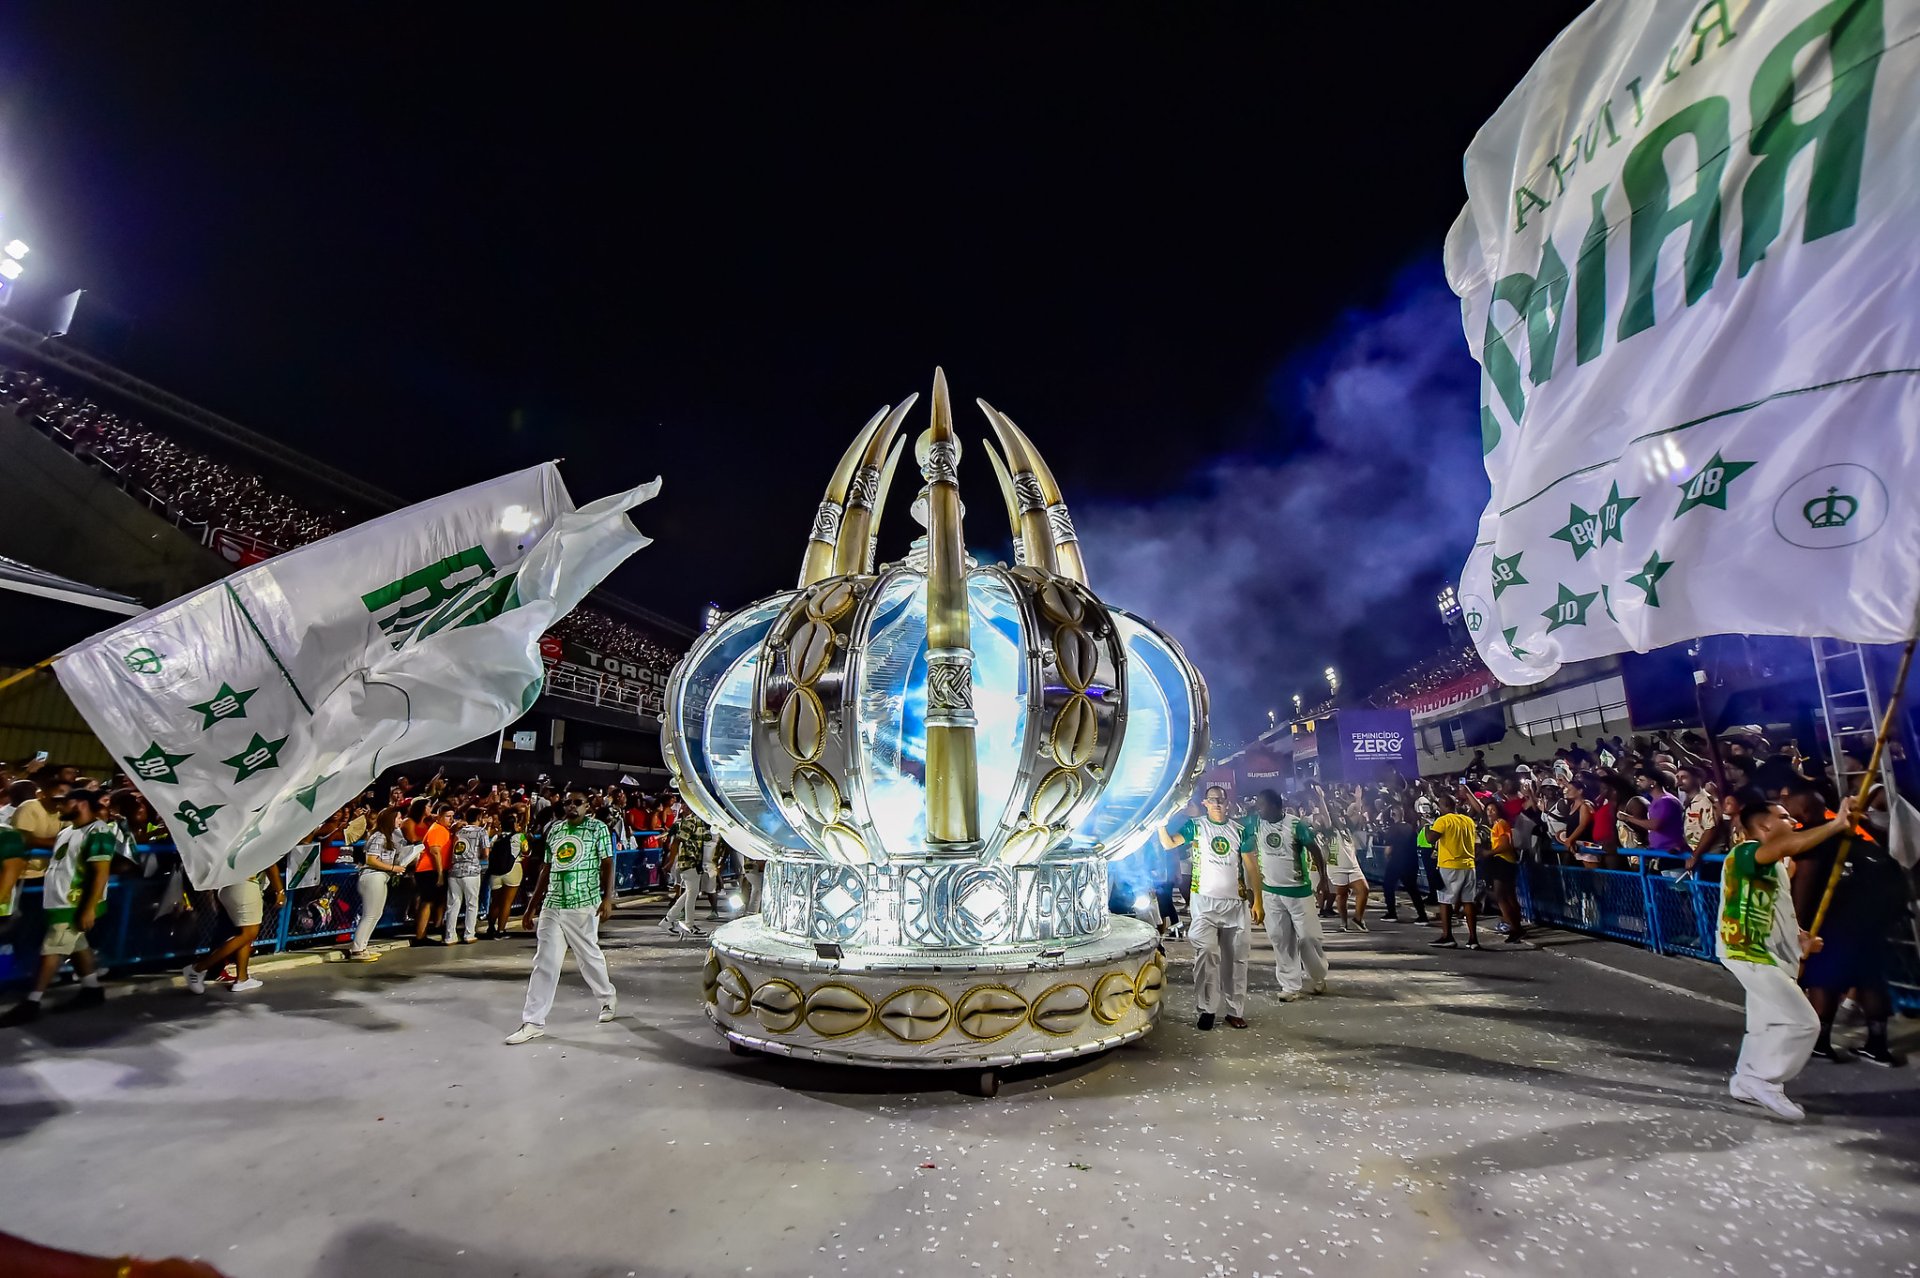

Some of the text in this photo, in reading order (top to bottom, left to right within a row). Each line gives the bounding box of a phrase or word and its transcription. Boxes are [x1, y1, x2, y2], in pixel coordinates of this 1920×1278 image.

[209, 695, 240, 718] 80
[1351, 731, 1401, 740] FEMINICÍDIO
[1352, 739, 1403, 753] ZERO
[134, 756, 171, 778] 99
[242, 747, 272, 771] 81
